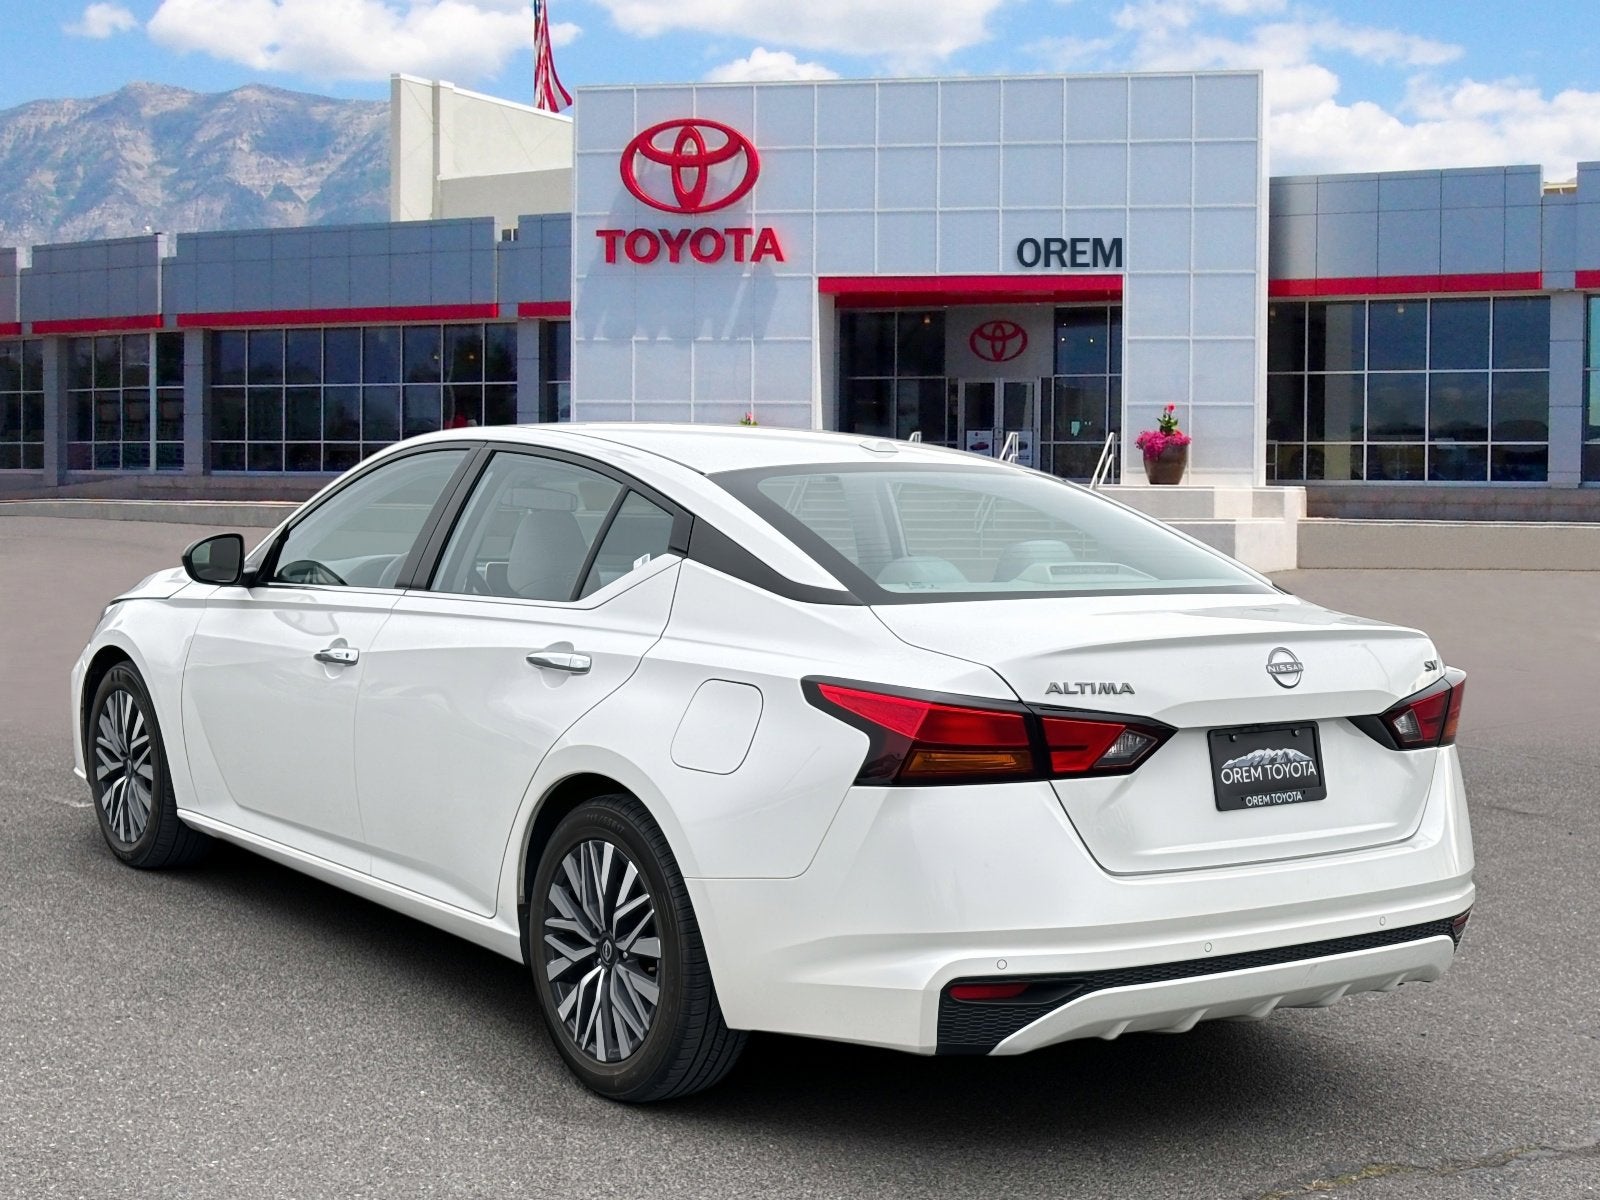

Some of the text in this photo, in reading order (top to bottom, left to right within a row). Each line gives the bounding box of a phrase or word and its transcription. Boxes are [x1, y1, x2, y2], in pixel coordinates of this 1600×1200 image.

[596, 227, 784, 264] TOYOTA
[1017, 237, 1123, 268] OREM
[1266, 663, 1304, 673] NISSAN
[1045, 682, 1135, 695] ALTIMA
[1221, 761, 1317, 785] OREM TOYOTA
[1245, 791, 1303, 807] OREM TOYOTA
